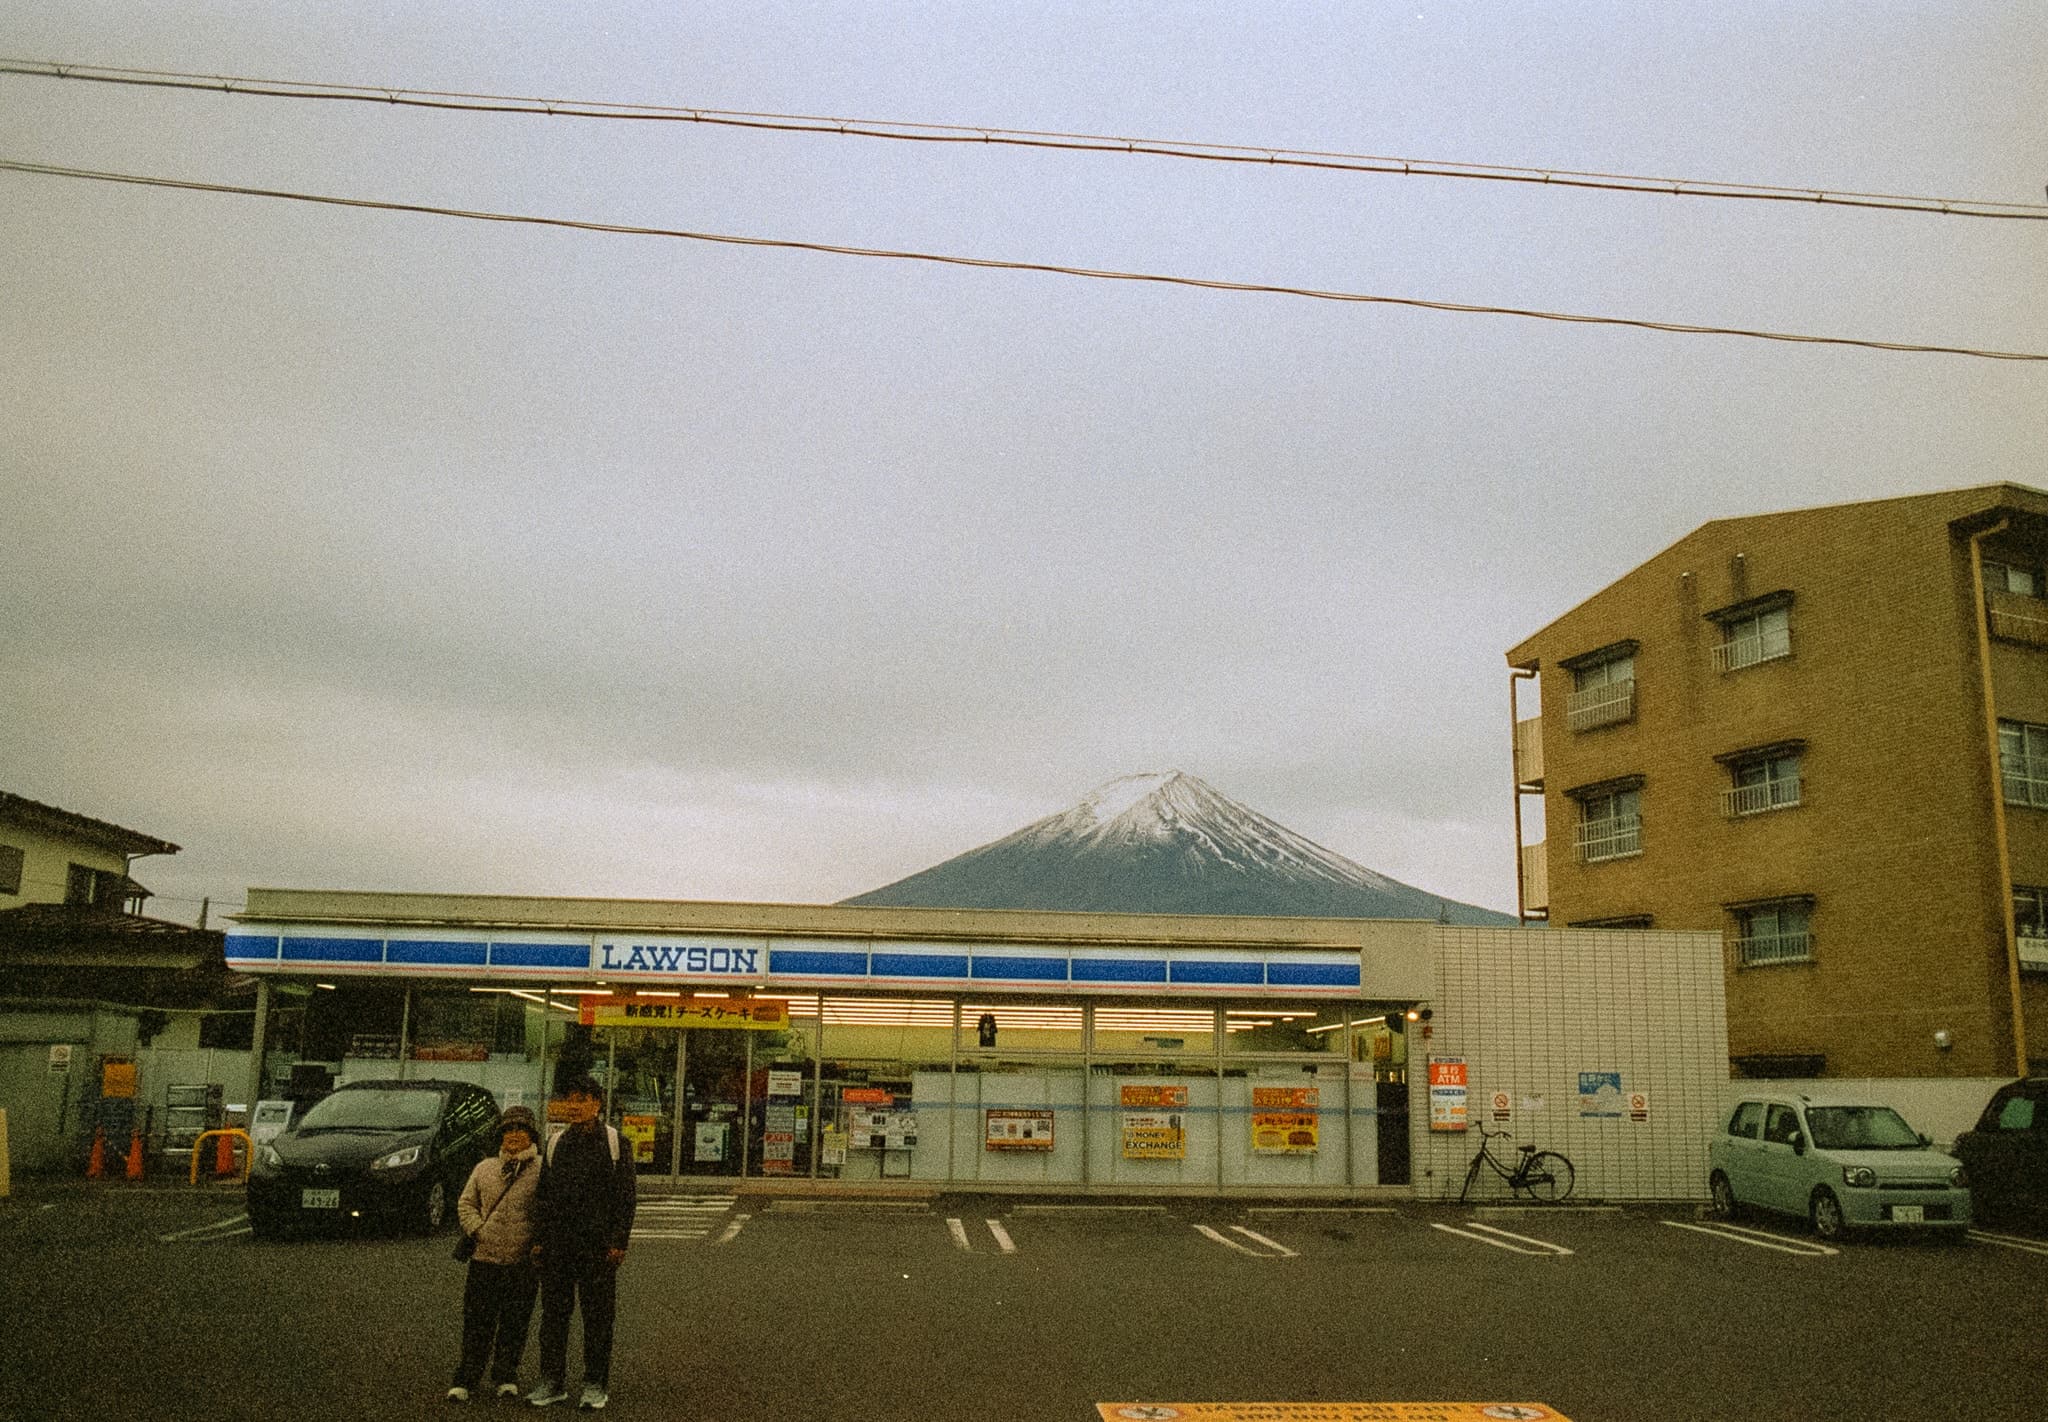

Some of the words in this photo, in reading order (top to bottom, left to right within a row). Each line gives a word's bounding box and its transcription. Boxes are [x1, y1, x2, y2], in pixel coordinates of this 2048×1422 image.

[602, 945, 758, 973] LAWSON
[1437, 1075, 1460, 1084] ATM
[1125, 1141, 1182, 1149] EXCHANGE
